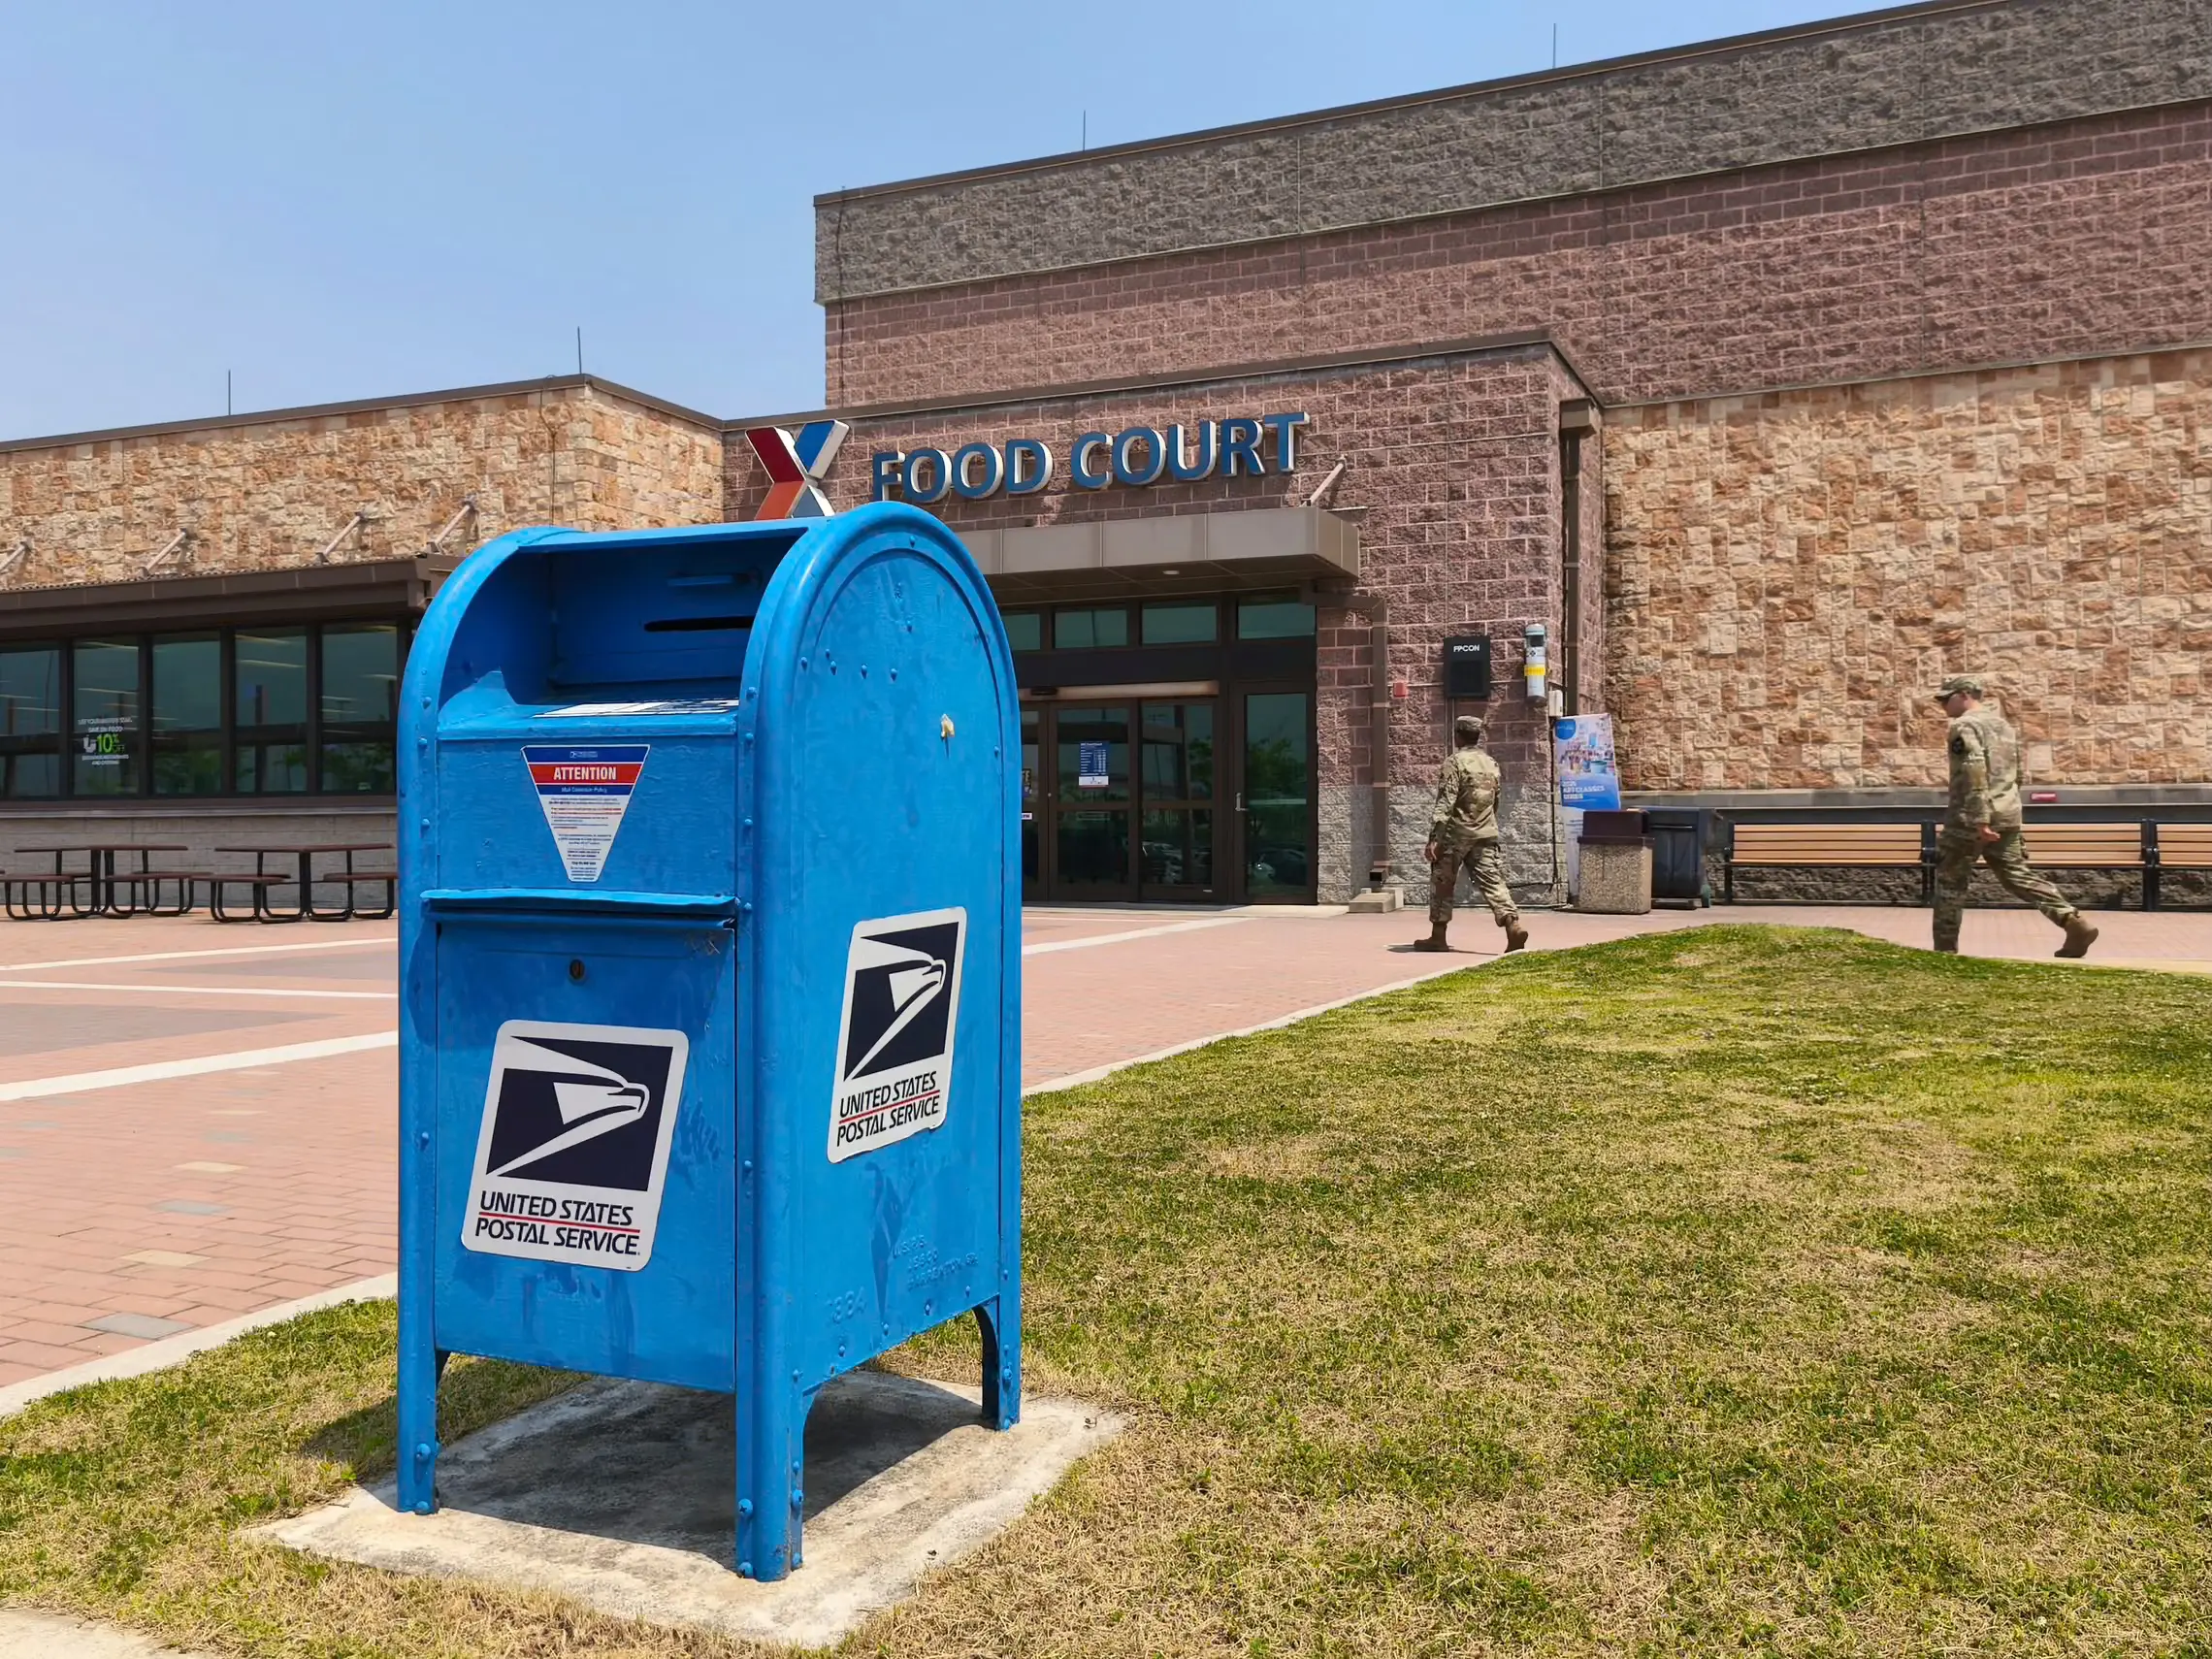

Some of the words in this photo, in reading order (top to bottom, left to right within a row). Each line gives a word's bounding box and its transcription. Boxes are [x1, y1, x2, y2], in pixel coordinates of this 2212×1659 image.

[872, 438, 1054, 503] FOOD
[1070, 411, 1310, 490] COURT
[553, 766, 617, 781] ATTENTION
[839, 1083, 892, 1119] UNITED
[893, 1070, 937, 1103] STATES
[836, 1113, 888, 1148] POSTAL
[889, 1094, 940, 1129] SERVICE
[479, 1190, 557, 1218] UNITED
[559, 1199, 634, 1226] STATES
[475, 1217, 549, 1246] POSTAL
[553, 1226, 640, 1256] SERVICE
